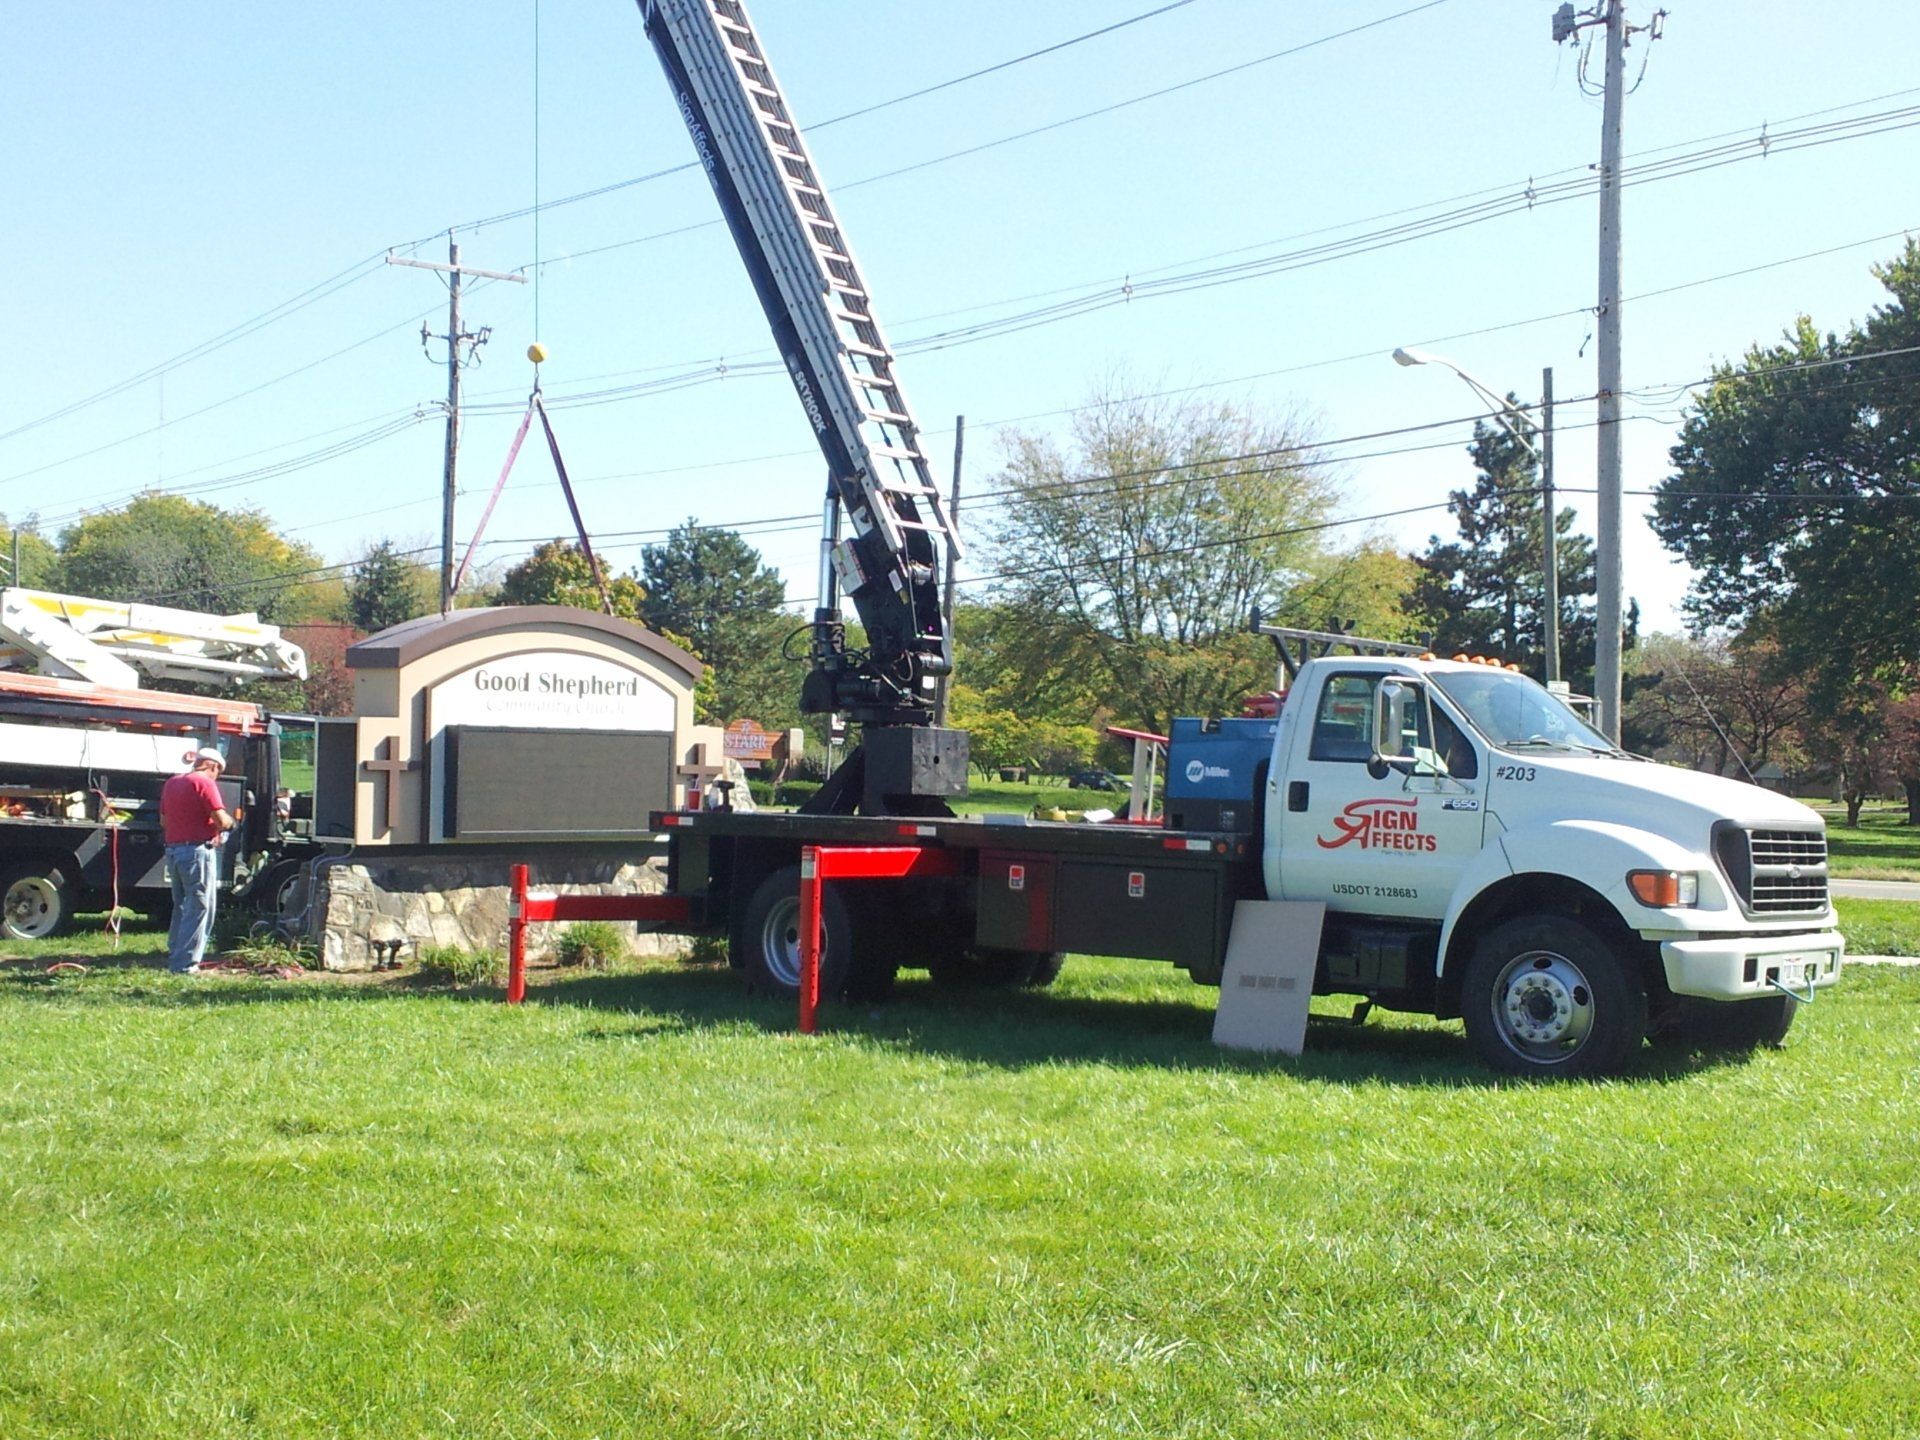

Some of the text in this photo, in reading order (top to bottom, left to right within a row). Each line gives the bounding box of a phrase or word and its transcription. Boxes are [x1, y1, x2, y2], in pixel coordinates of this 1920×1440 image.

[795, 371, 827, 434] SKYHOOK
[474, 669, 638, 699] Good Shepherd
[725, 734, 768, 750] STARR
[1496, 766, 1536, 782] #203
[1333, 797, 1418, 832] SIGN
[1317, 817, 1437, 851] AFFECTS
[1332, 883, 1418, 899] USDOT 2128683
